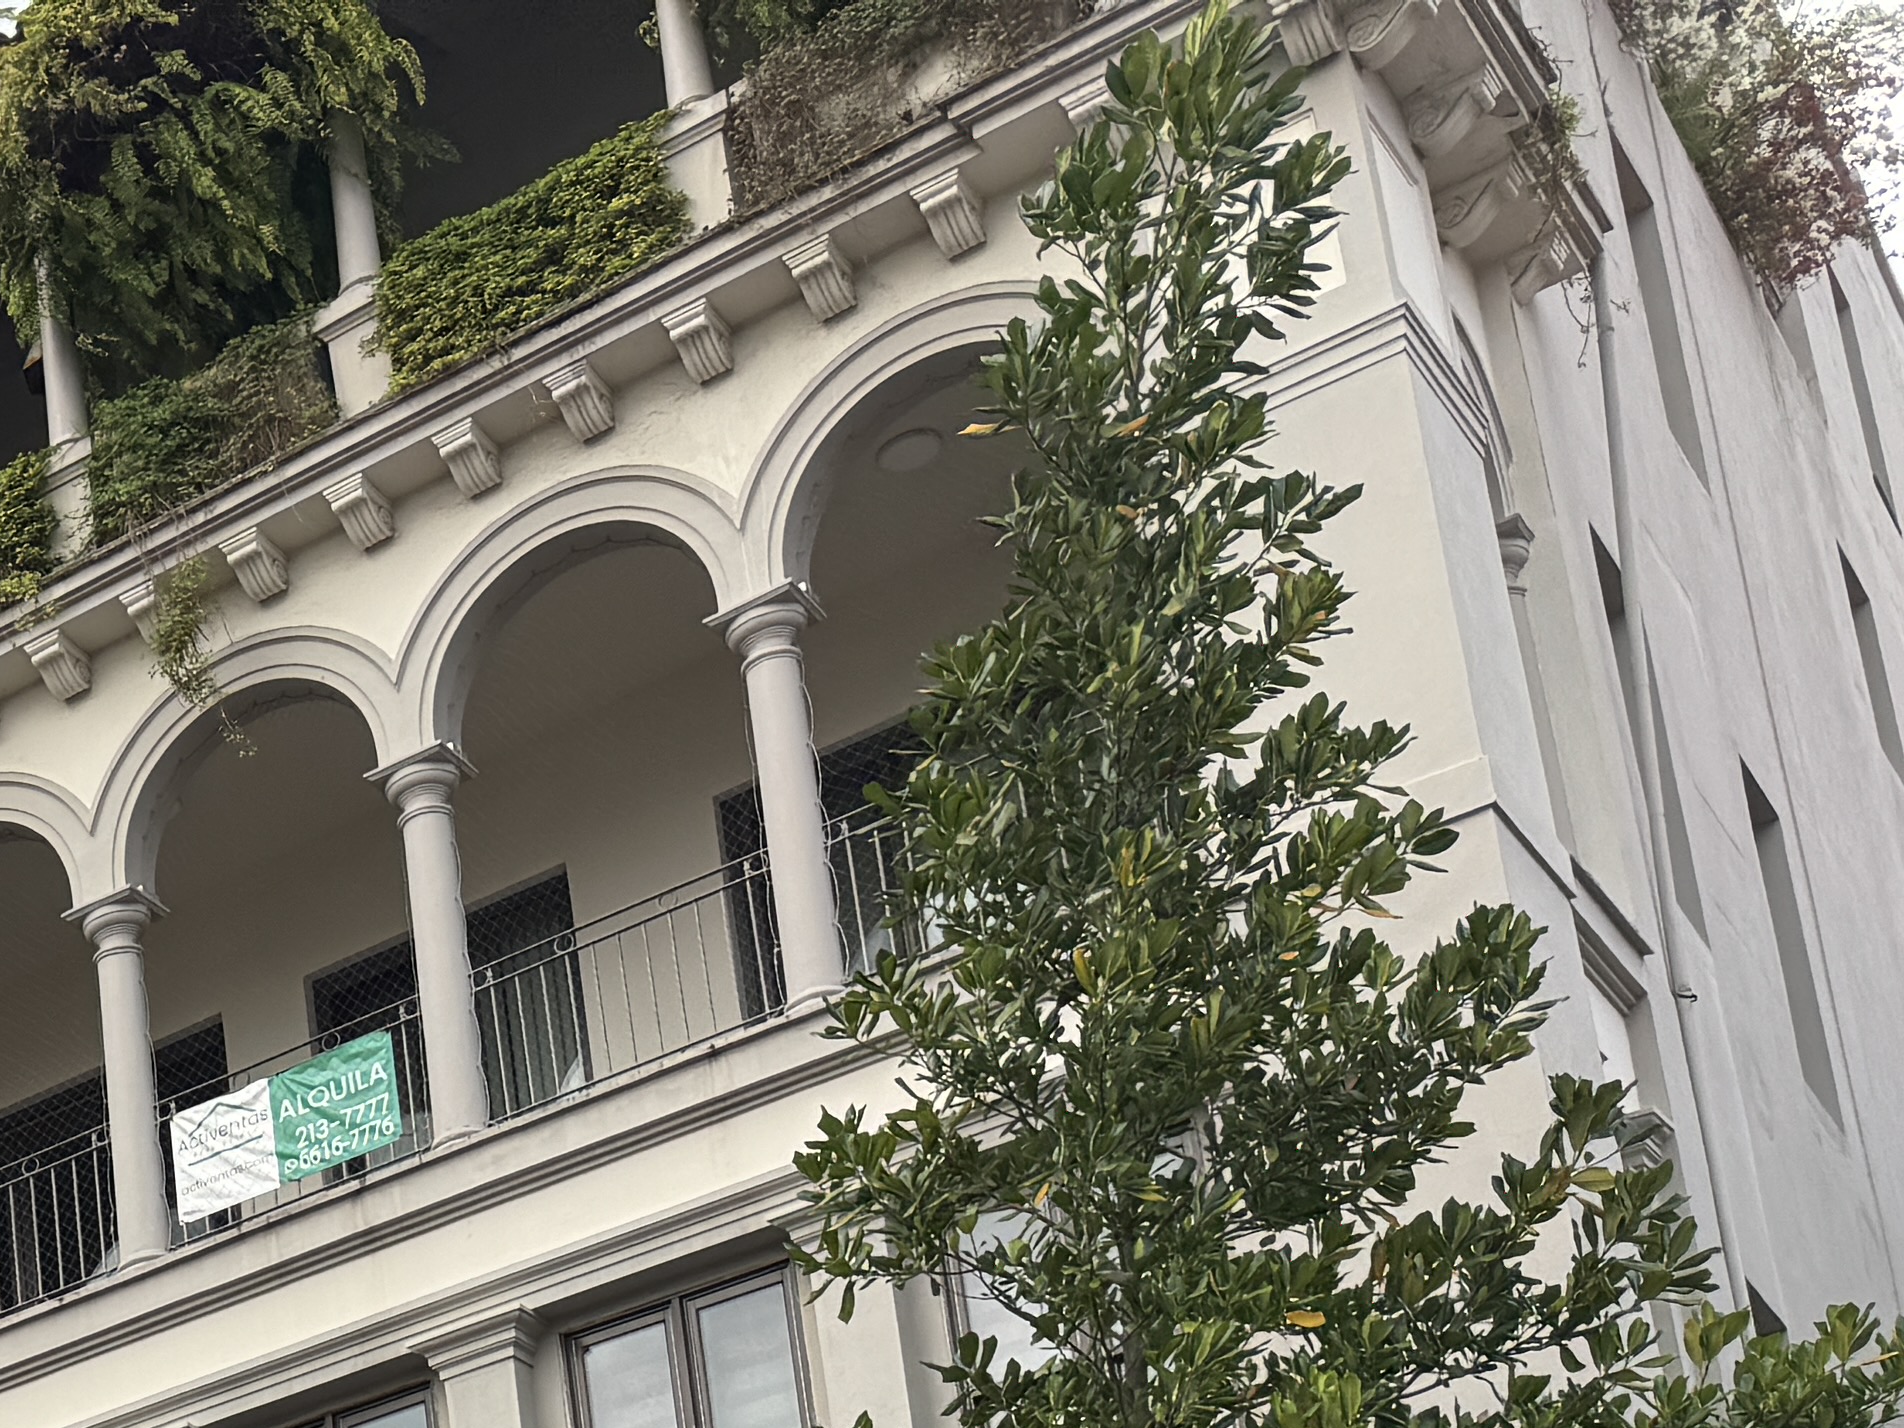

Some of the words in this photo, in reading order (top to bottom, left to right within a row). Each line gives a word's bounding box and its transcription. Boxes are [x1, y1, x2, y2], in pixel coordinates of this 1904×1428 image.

[279, 1062, 388, 1123] ALQUILA
[295, 1092, 389, 1149] 213-7777
[299, 1115, 395, 1169] 6616-7776
